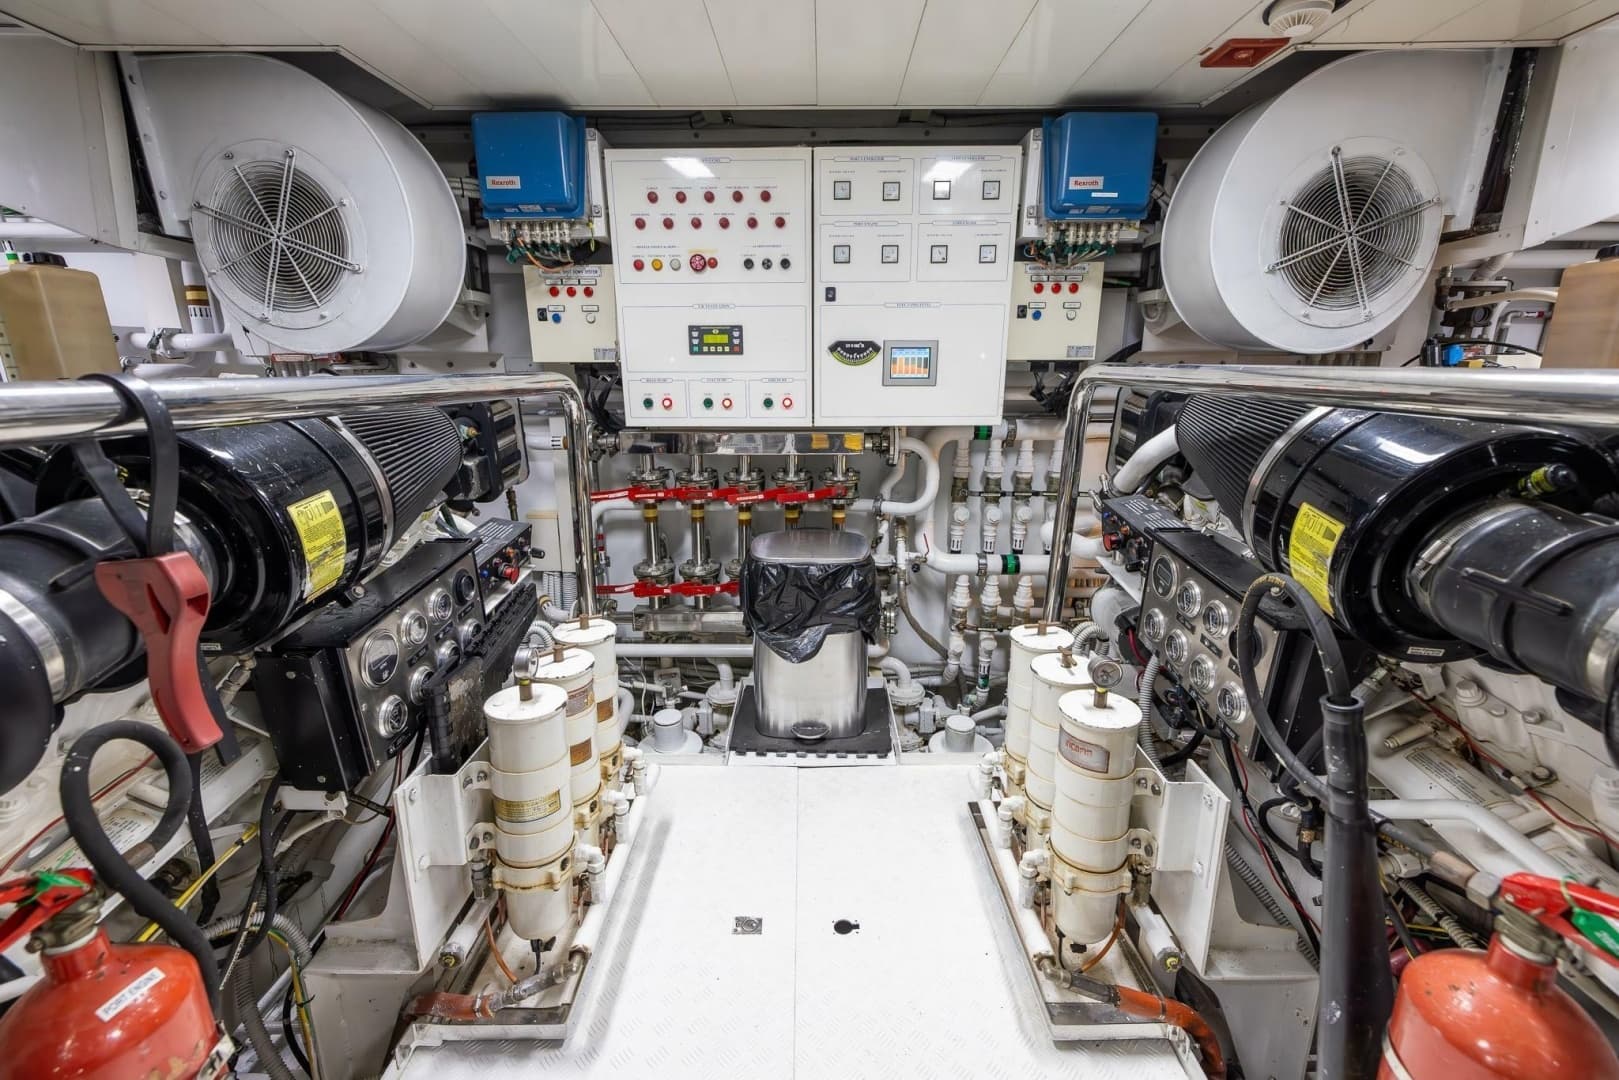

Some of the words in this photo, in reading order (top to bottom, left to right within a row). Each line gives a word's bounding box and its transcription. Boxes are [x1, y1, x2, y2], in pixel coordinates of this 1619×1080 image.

[1074, 179, 1099, 187] Rexroth
[103, 993, 127, 1015] PORT
[128, 970, 159, 995] ENGINE
